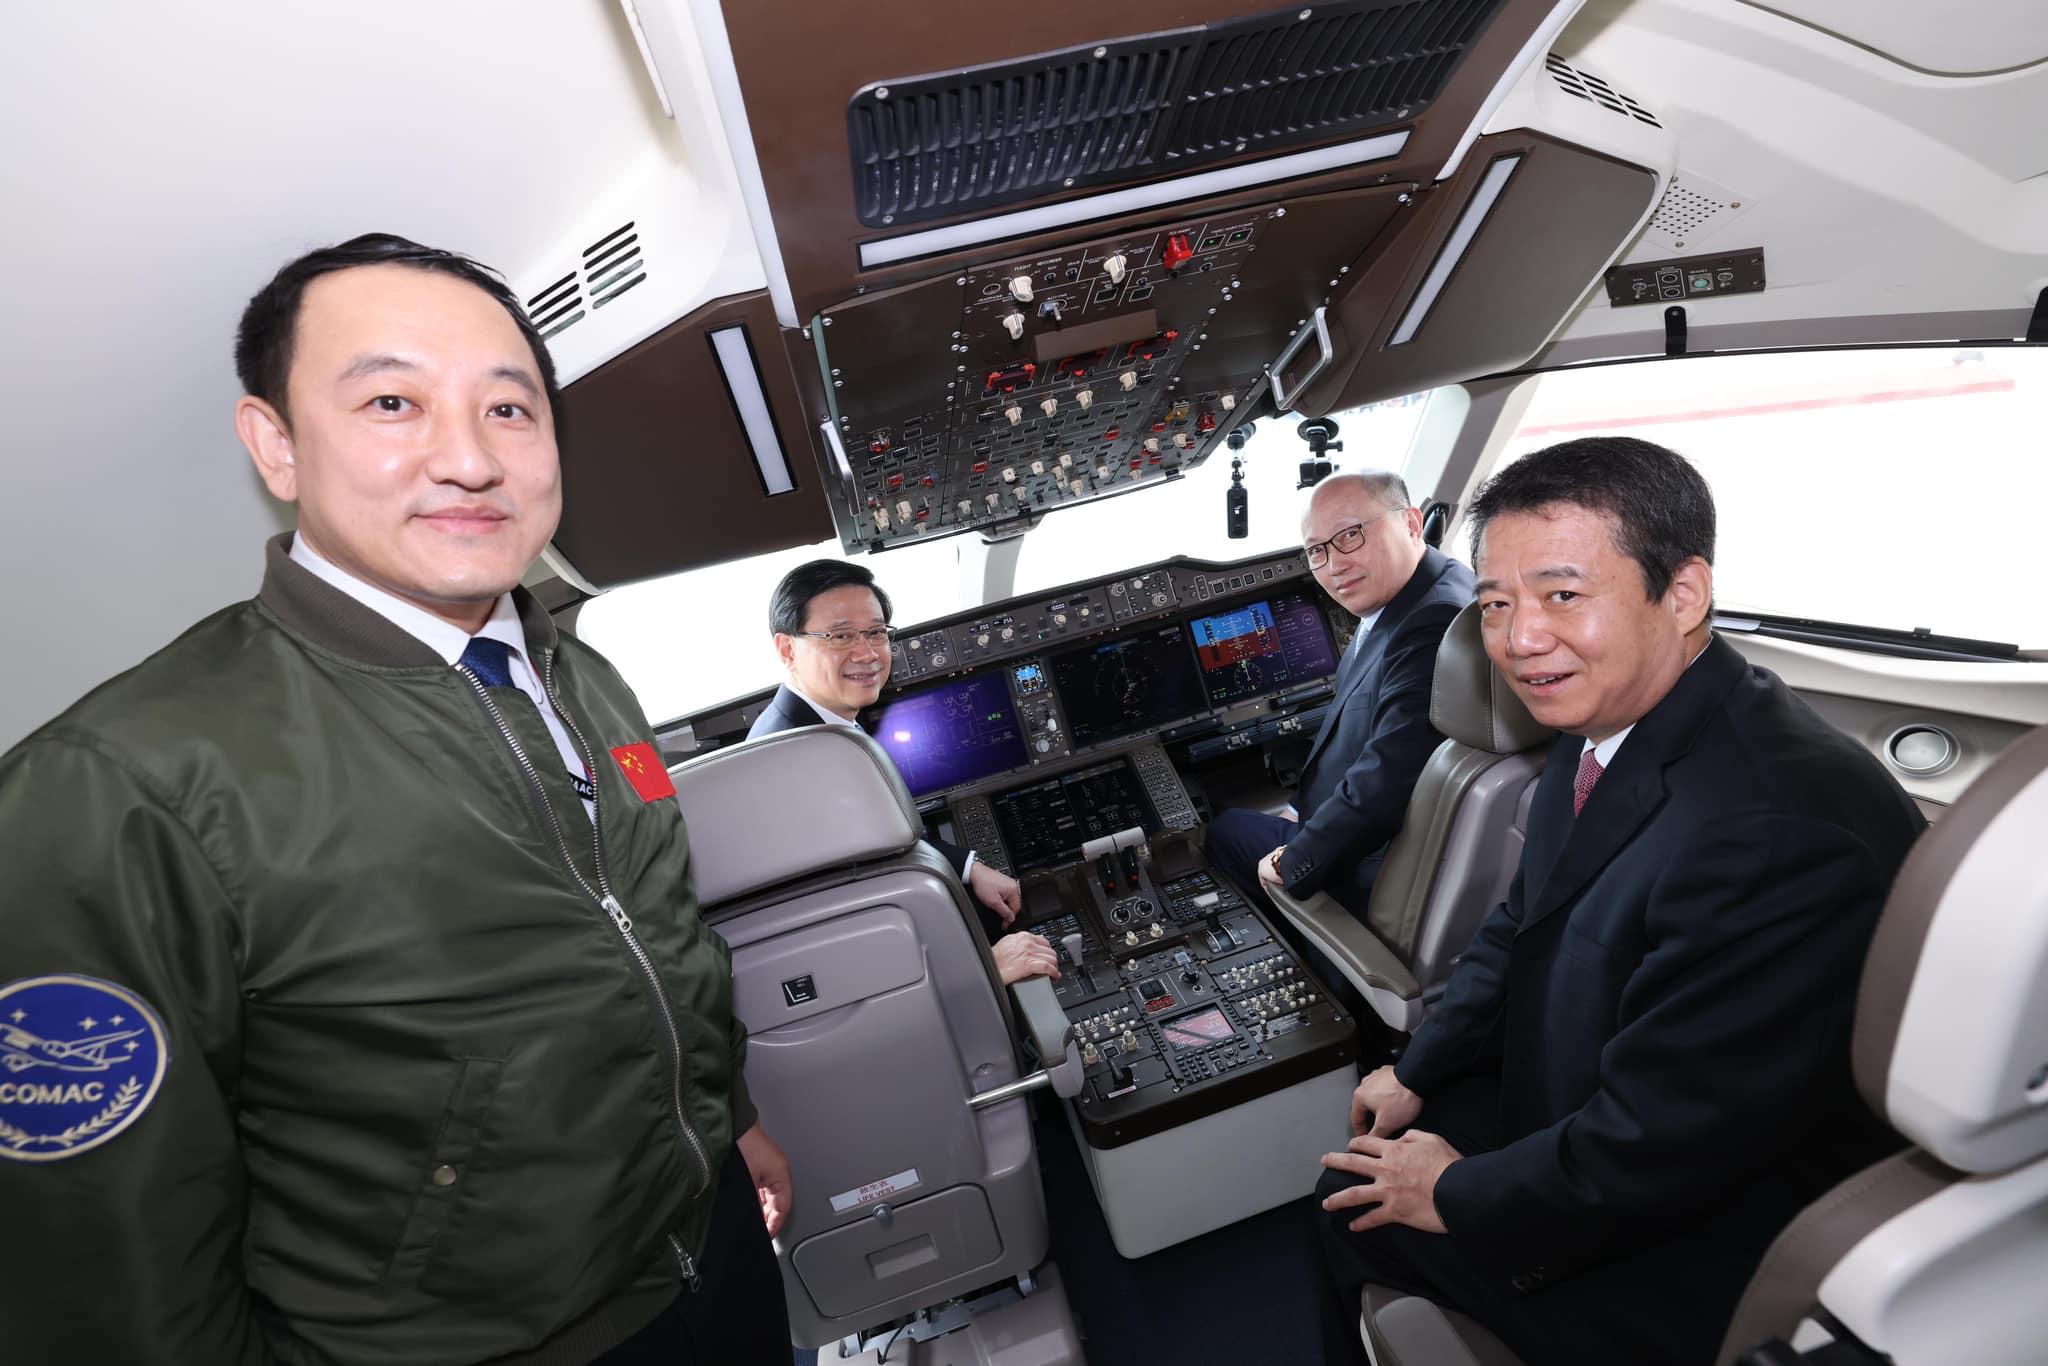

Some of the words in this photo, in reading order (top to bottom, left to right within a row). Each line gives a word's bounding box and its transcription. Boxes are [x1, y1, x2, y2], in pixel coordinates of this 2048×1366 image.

[0, 1082, 104, 1104] COMAC
[857, 1193, 874, 1203] LIFE
[876, 1185, 896, 1198] VEST
